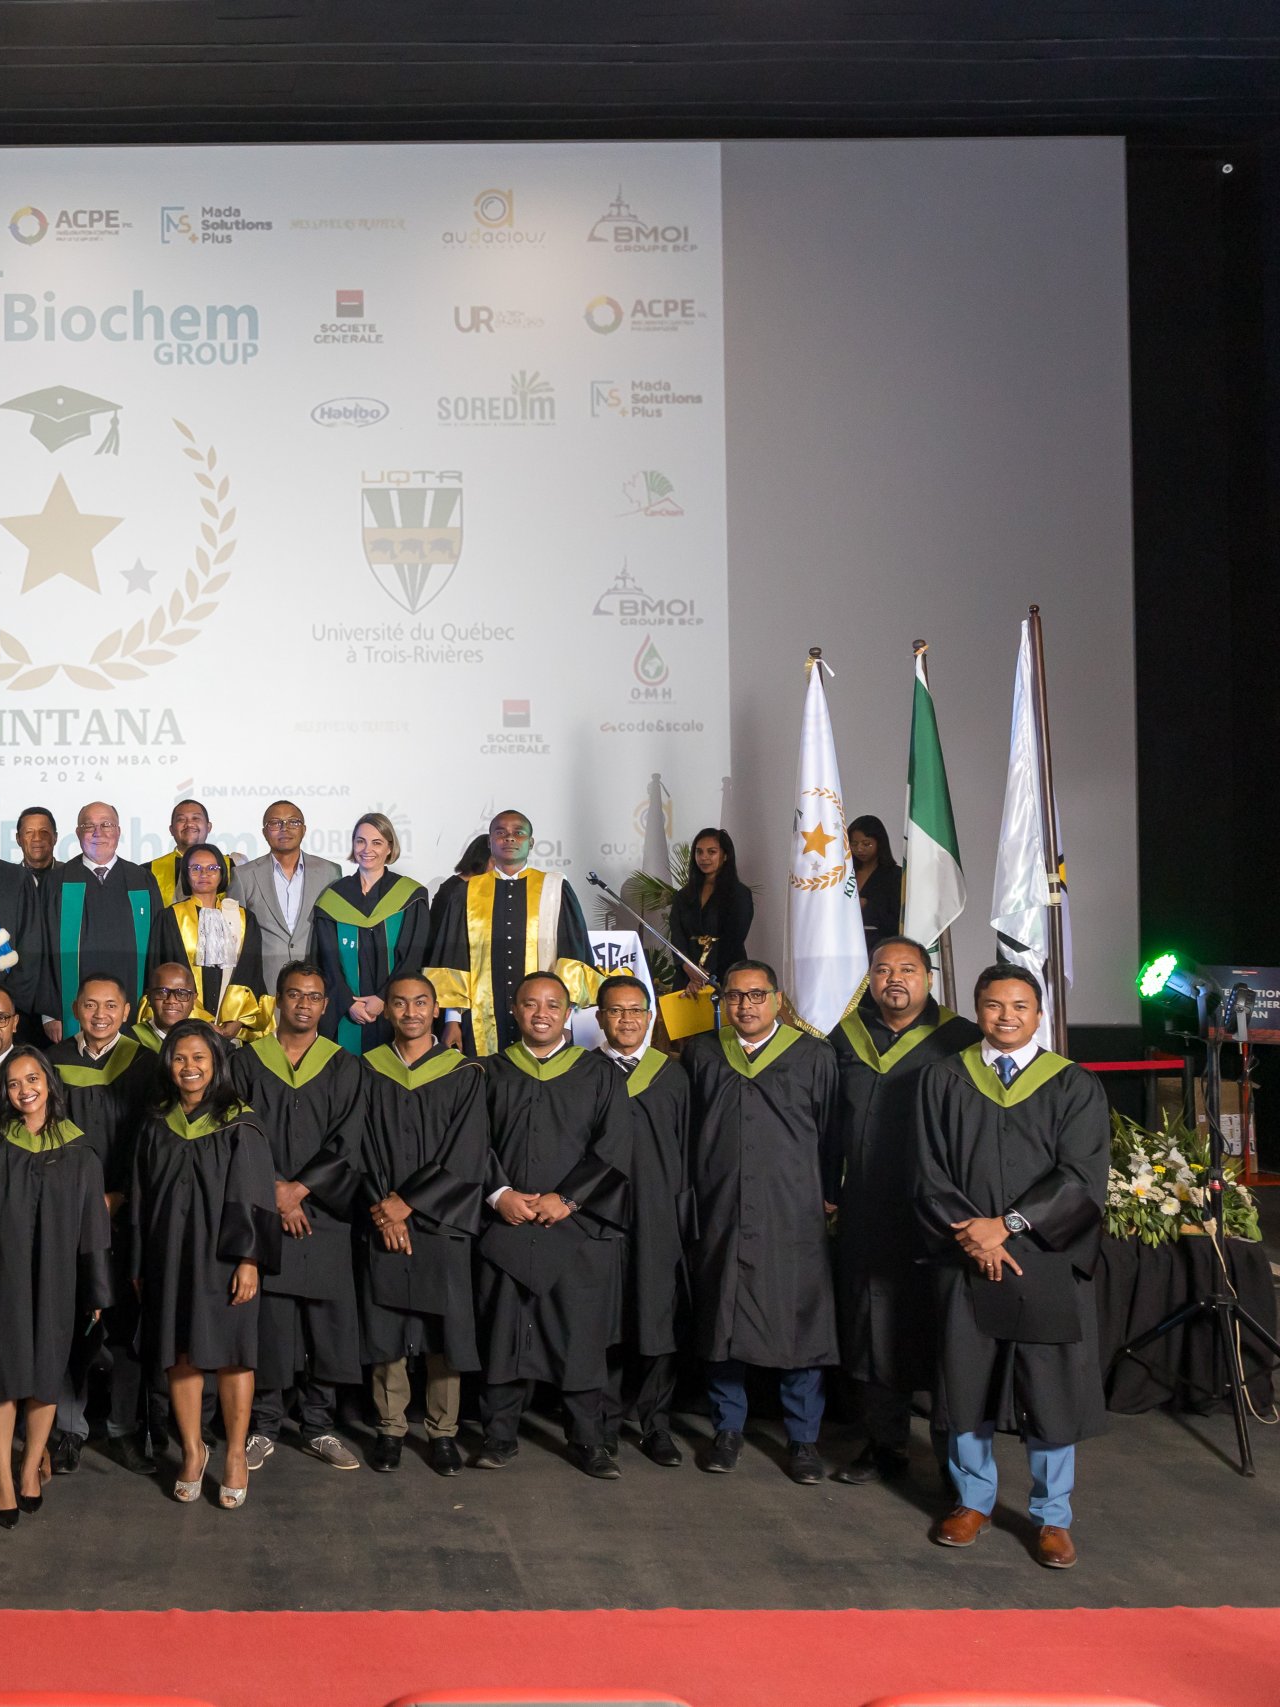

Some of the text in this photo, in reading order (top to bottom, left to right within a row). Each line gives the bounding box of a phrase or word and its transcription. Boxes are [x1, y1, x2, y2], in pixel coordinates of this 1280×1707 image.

[201, 206, 242, 218] Mada
[55, 210, 120, 228] ACPE
[201, 218, 273, 231] Solutions
[201, 232, 233, 245] Plus
[614, 226, 690, 243] BMOI
[615, 244, 699, 253] GROUPE BCP
[631, 299, 697, 318] ACPE
[4, 290, 259, 343] Biochem
[454, 306, 495, 333] UR
[320, 324, 377, 333] SOCIETE
[314, 334, 383, 344] GENERALE
[154, 342, 259, 365] GROUP
[631, 380, 671, 392] Mada
[631, 393, 703, 405] Solutions
[319, 405, 381, 421] Habibo
[631, 406, 663, 418] Plus
[362, 470, 463, 485] UQTR
[619, 600, 695, 616] BMOI
[620, 617, 705, 626] GROUPE BCP
[312, 622, 515, 645] Université du Québec
[346, 645, 484, 664] à Trois-Rivières
[618, 720, 704, 733] code&scale
[486, 733, 543, 743] SOCIETE
[480, 744, 550, 755] GENERALE
[14, 755, 110, 766] PROMOTION
[117, 755, 152, 766] MBA
[201, 785, 350, 798] BNI MADAGASCAR
[592, 942, 638, 973] SCAE
